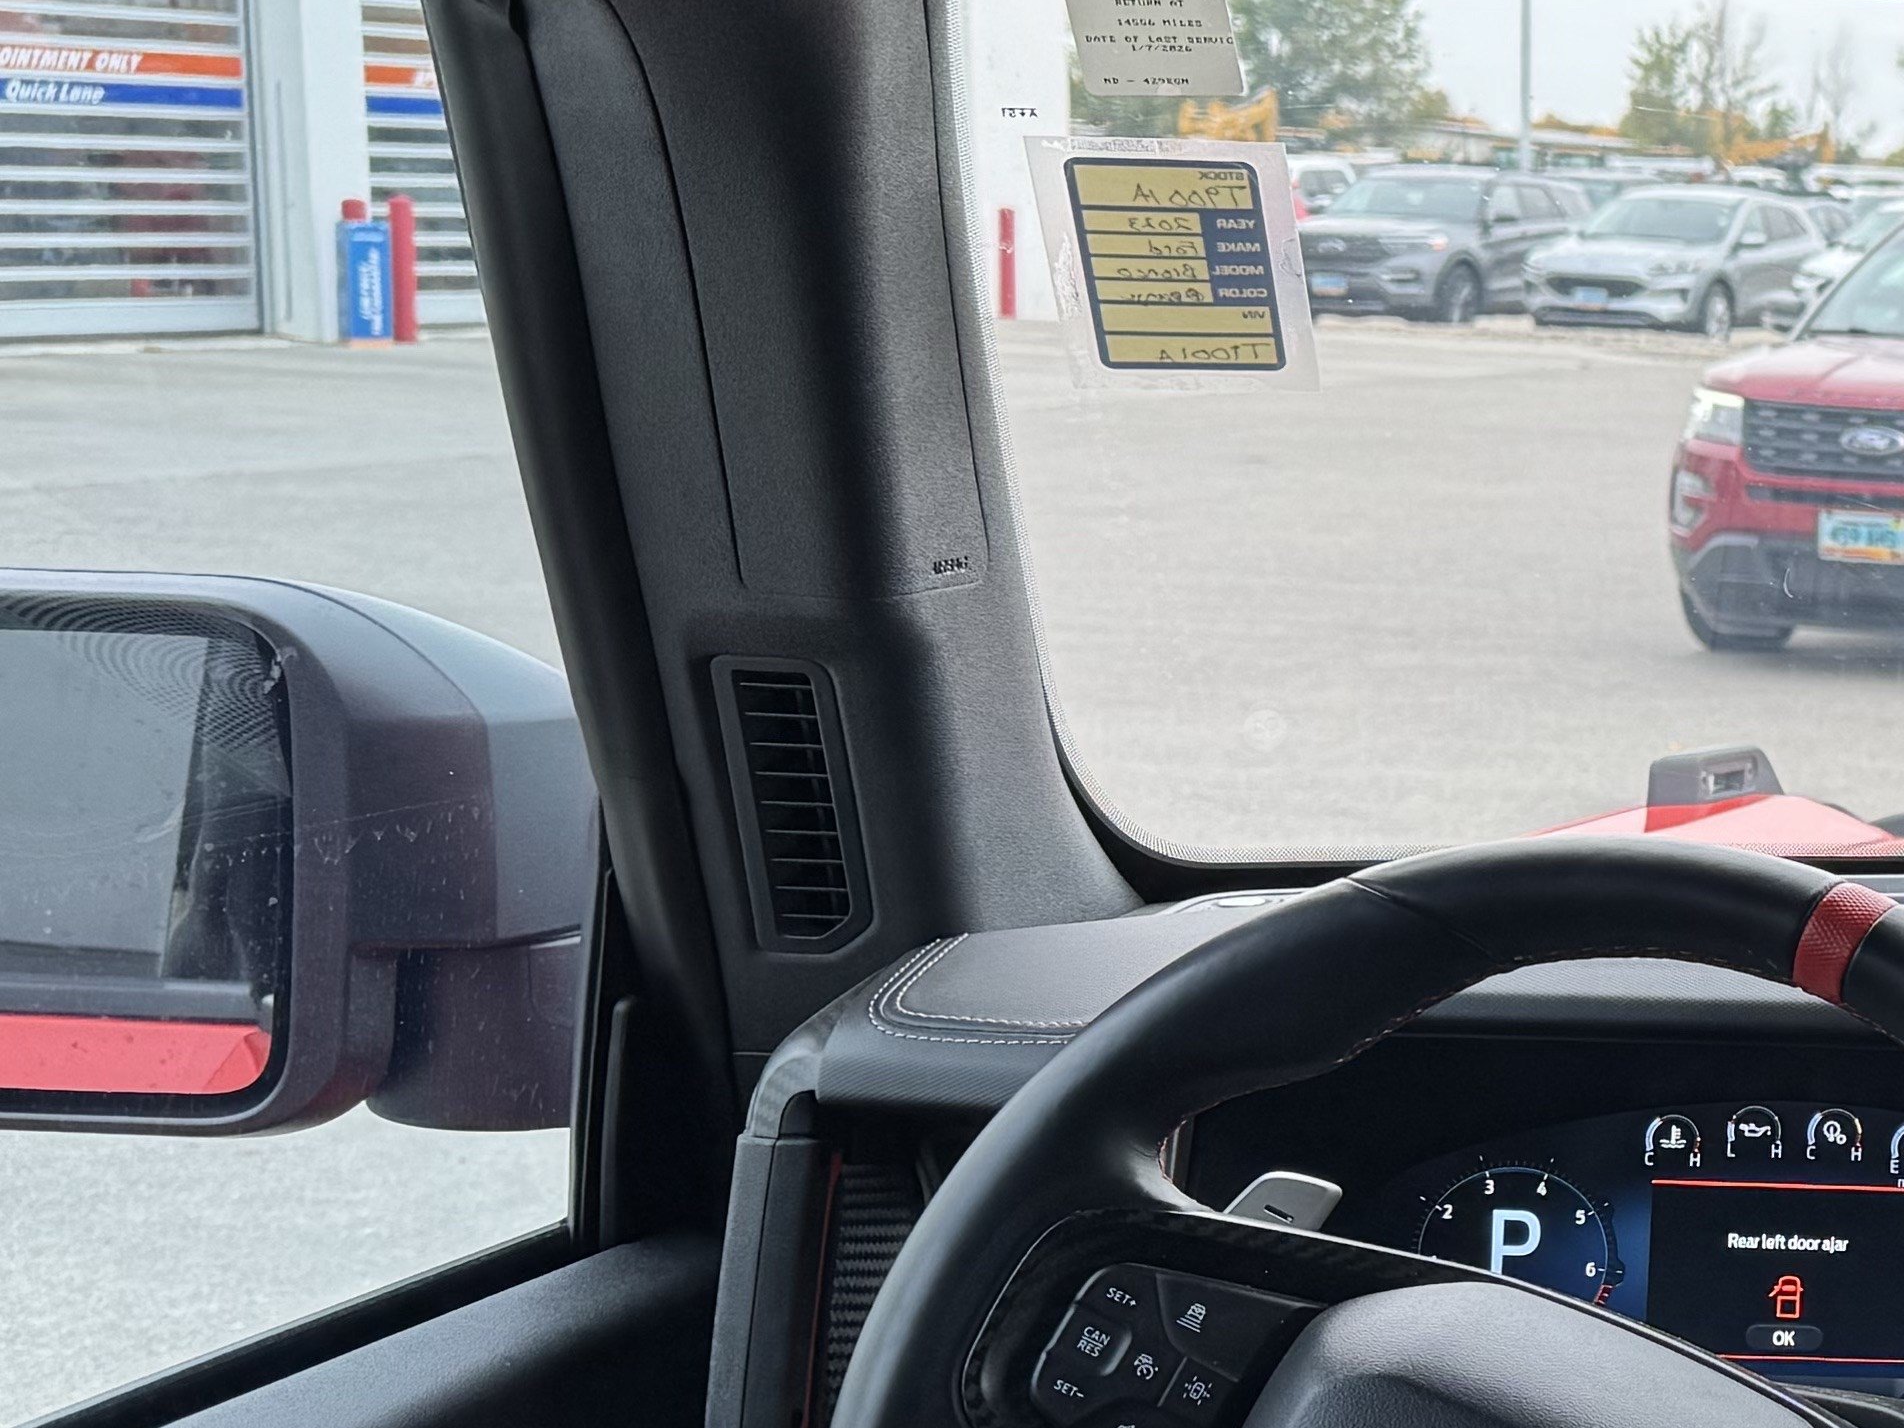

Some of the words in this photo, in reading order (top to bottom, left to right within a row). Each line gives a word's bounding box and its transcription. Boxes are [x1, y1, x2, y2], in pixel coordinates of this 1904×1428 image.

[1114, 0, 1161, 7] RETURN
[1162, 19, 1203, 28] MILES
[1085, 35, 1116, 44] DATE
[1124, 35, 1139, 44] OF
[1149, 35, 1178, 44] LAST
[95, 52, 142, 73] ONLY
[5, 79, 58, 103] Quick
[59, 83, 105, 105] Lane
[1645, 1152, 1654, 1166] C
[1726, 1143, 1735, 1158] L
[1771, 1143, 1782, 1159] H
[1806, 1145, 1816, 1160] C
[1851, 1146, 1862, 1162] H
[1689, 1153, 1701, 1168] H
[1484, 1179, 1495, 1196] 3
[1537, 1180, 1548, 1198] 4
[1441, 1203, 1454, 1221] 2
[1575, 1209, 1586, 1226] 5
[1490, 1208, 1542, 1274] P
[1727, 1232, 1759, 1250] Rear
[1761, 1233, 1786, 1251] left
[1787, 1234, 1820, 1252] door
[1821, 1235, 1849, 1254] ajar
[1585, 1261, 1596, 1278] 6
[1082, 1325, 1111, 1347] CAN
[1771, 1329, 1797, 1347] OK
[1076, 1339, 1101, 1358] RES
